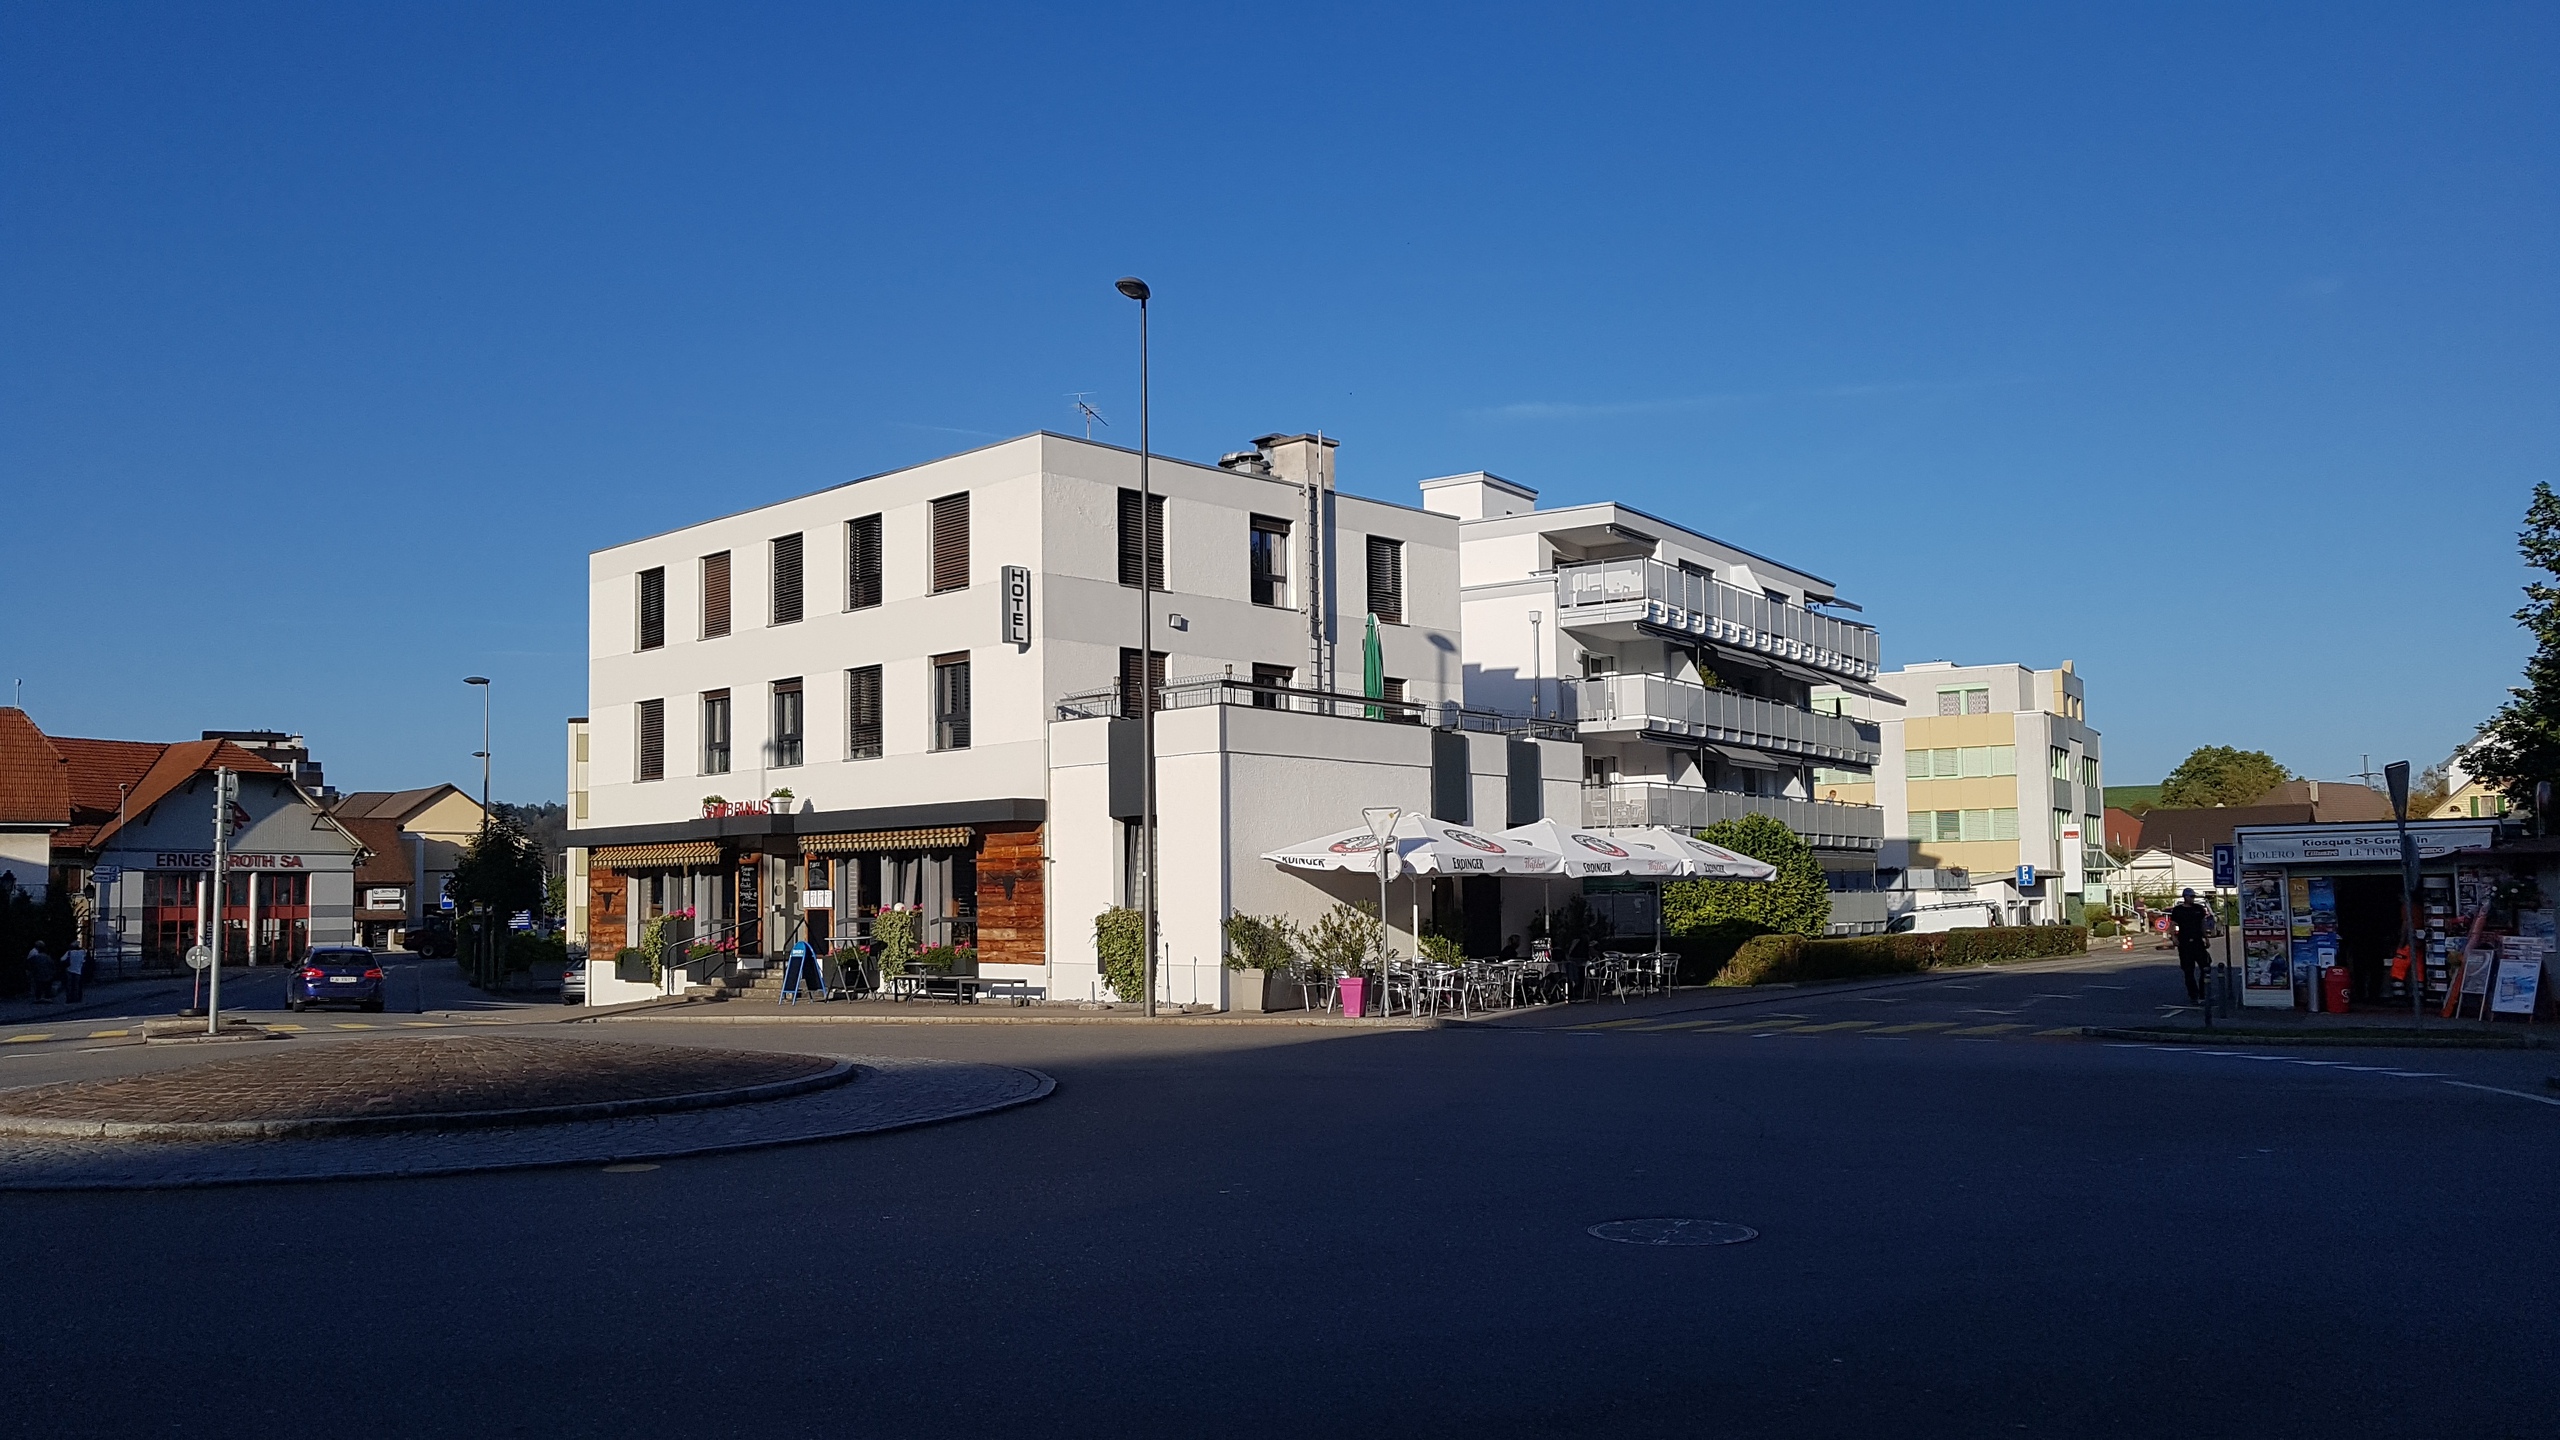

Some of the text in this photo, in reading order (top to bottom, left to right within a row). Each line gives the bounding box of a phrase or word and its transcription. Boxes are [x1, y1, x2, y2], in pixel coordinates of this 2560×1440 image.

[1011, 568, 1024, 641] HOTEL
[2302, 836, 2428, 847] Kiosque St-Gerin
[228, 854, 276, 868] ROTH
[280, 854, 303, 868] SA
[2216, 850, 2228, 874] P
[2249, 851, 2295, 859] BOLERO
[1452, 857, 1485, 871] ERDINGER
[1583, 862, 1612, 874] ERDINGER
